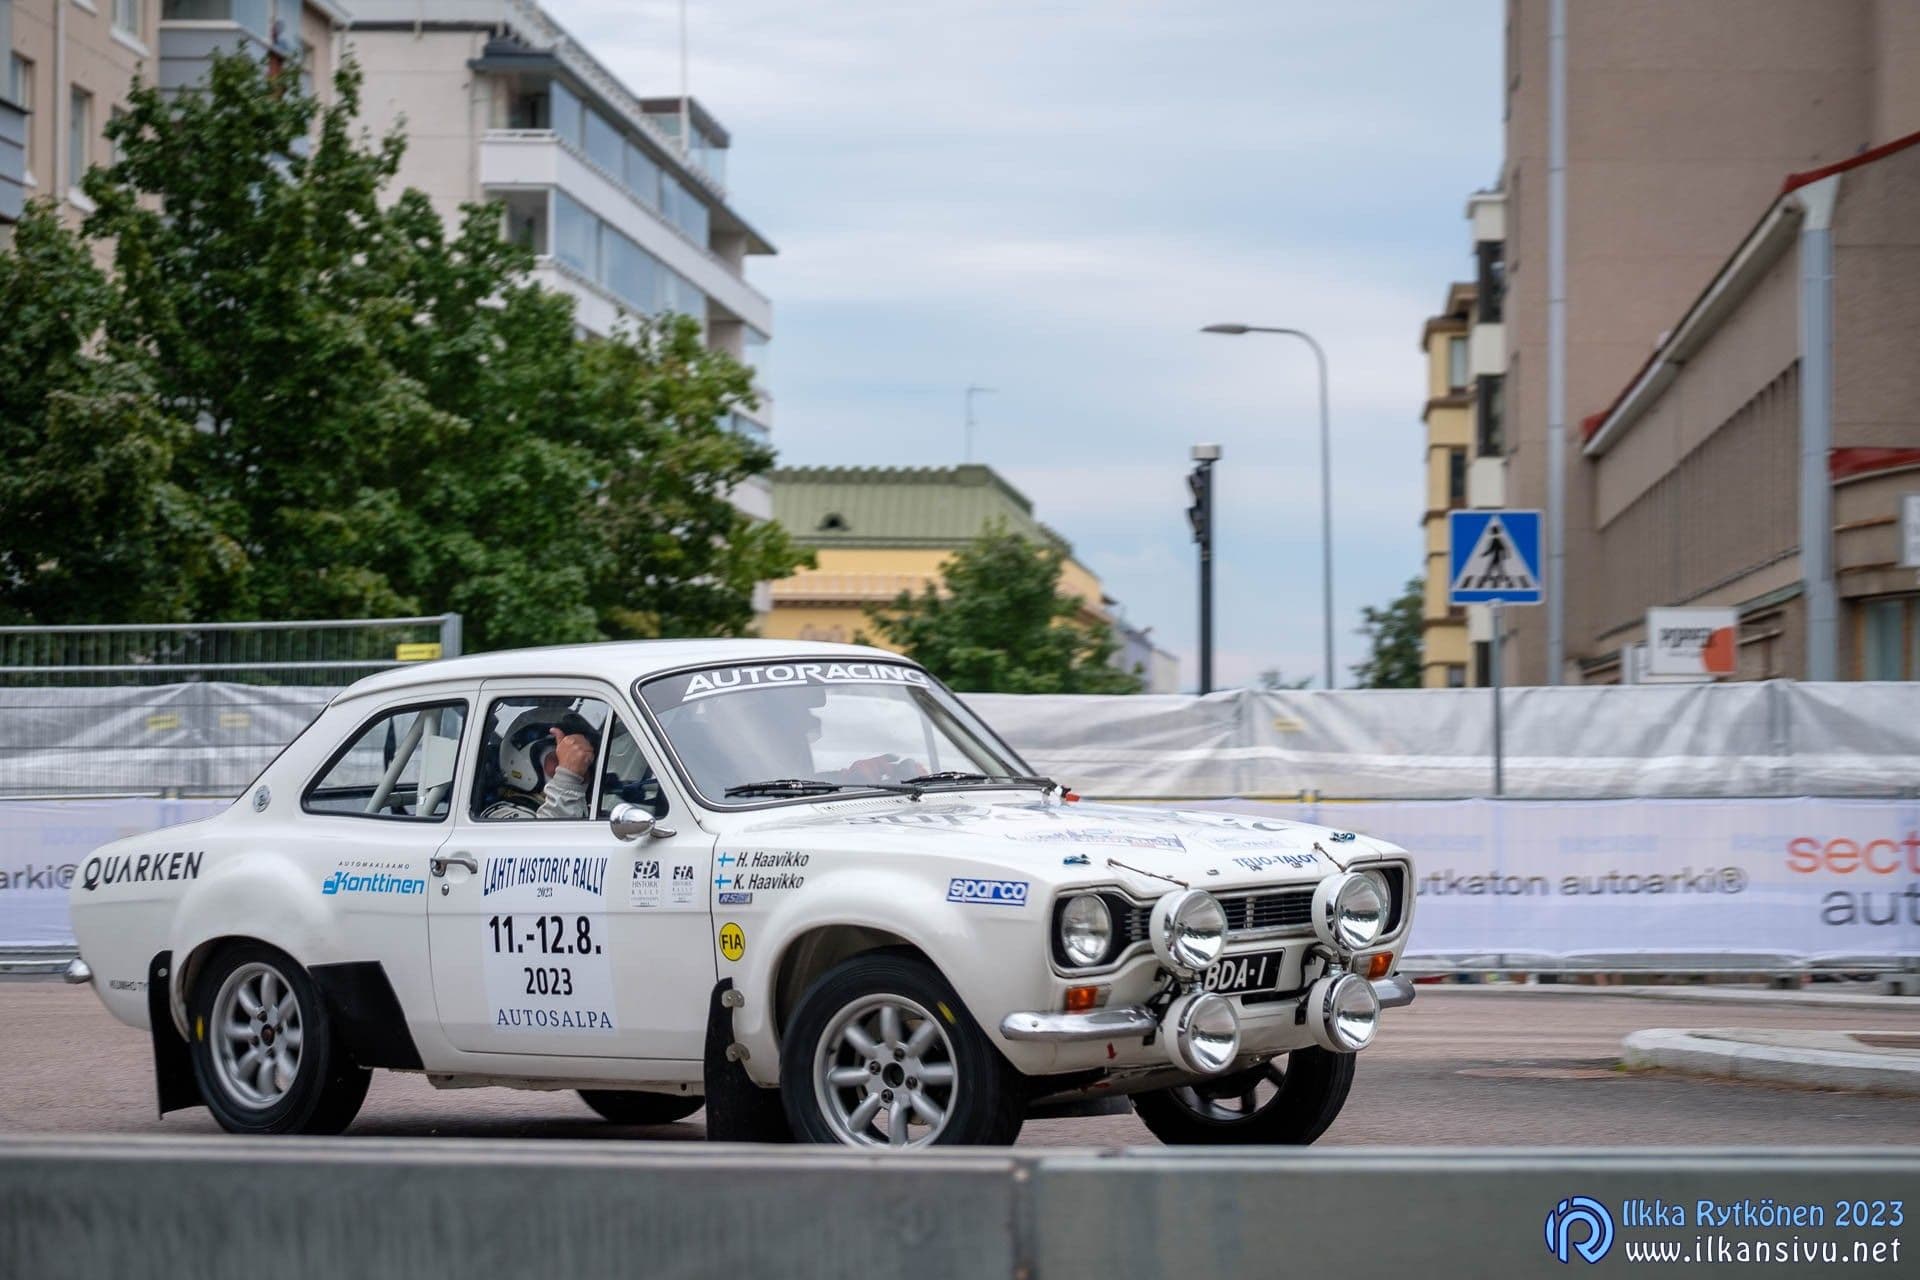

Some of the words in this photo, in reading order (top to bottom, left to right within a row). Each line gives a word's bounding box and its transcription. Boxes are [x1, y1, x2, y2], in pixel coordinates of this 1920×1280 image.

[685, 664, 928, 695] AUTORACING
[82, 851, 204, 891] QUARKEN
[736, 852, 748, 867] H.
[752, 852, 809, 867] Haavikko
[323, 871, 425, 894] Konttinen
[484, 858, 517, 896] LAHTI
[518, 858, 570, 885] HISTORIC
[572, 858, 607, 896] RALLY
[734, 874, 745, 889] K.
[748, 873, 804, 889] Haavikko
[951, 880, 1026, 901] sparco
[489, 915, 602, 955] 11.-12.8.
[722, 934, 743, 950] FIA
[524, 967, 573, 995] 2023
[497, 1008, 612, 1029] AUTOSALPA
